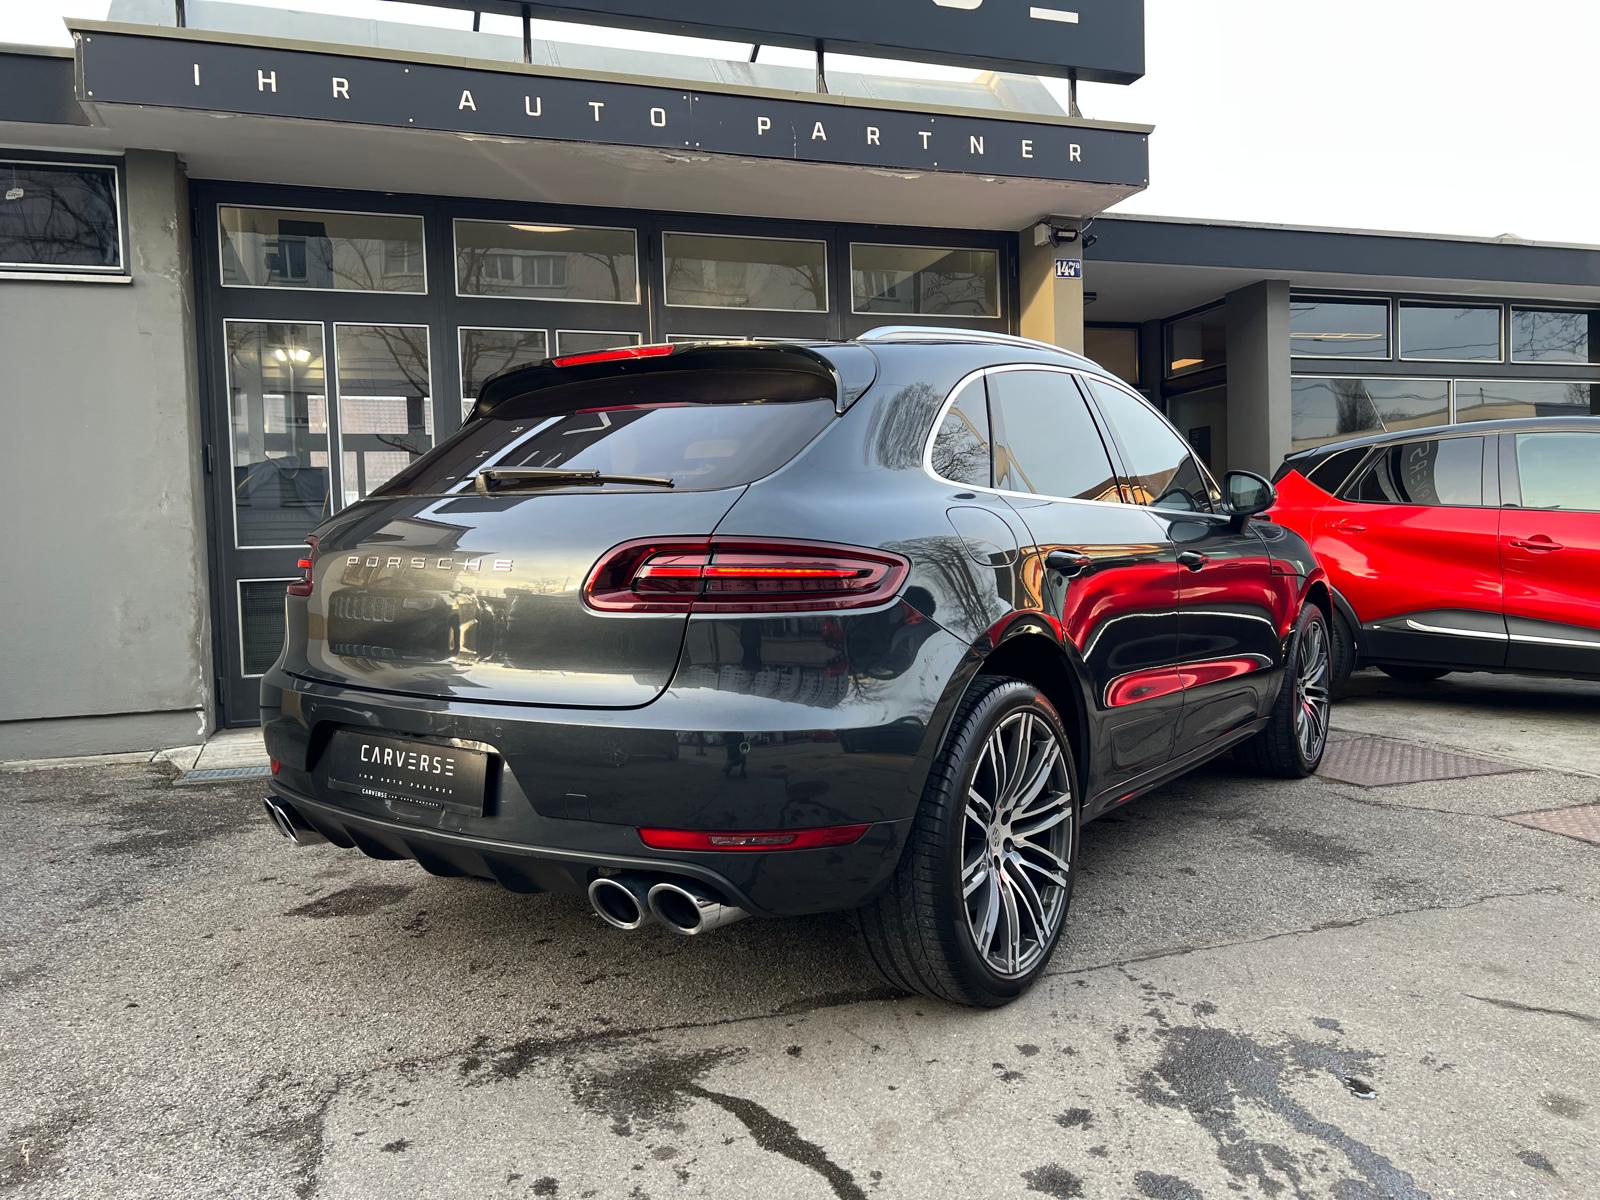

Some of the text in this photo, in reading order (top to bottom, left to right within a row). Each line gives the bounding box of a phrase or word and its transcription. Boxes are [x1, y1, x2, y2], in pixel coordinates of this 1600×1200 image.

[193, 63, 1082, 163] IHR AUTO PARTNER
[346, 556, 513, 572] PORSCHE
[360, 744, 455, 776] CARVERSE
